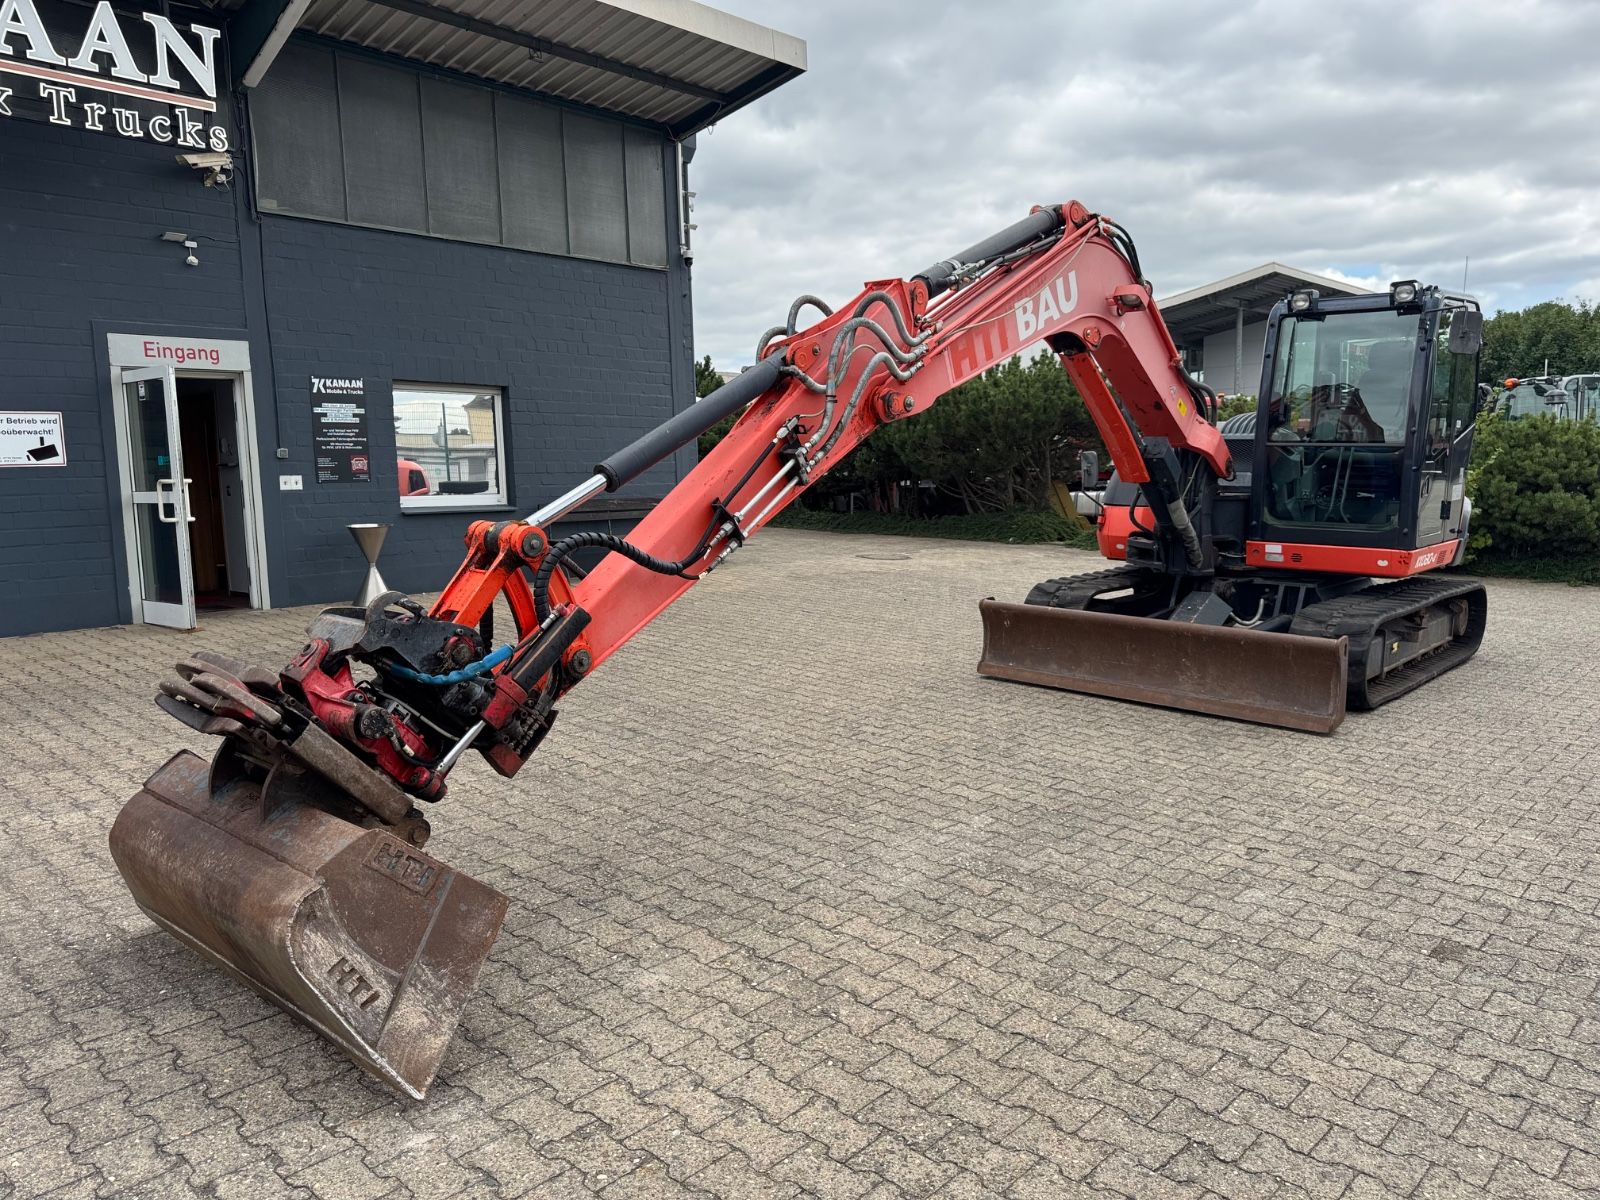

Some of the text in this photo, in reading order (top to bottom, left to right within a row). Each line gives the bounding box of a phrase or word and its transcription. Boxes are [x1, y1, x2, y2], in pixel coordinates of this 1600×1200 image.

[40, 82, 229, 152] Trucks
[1014, 270, 1078, 342] BAU
[143, 341, 220, 365] Eingang
[326, 378, 363, 388] KANAAN
[6, 417, 38, 425] Betrieb
[39, 417, 58, 425] wird
[326, 956, 381, 1011] HTI
